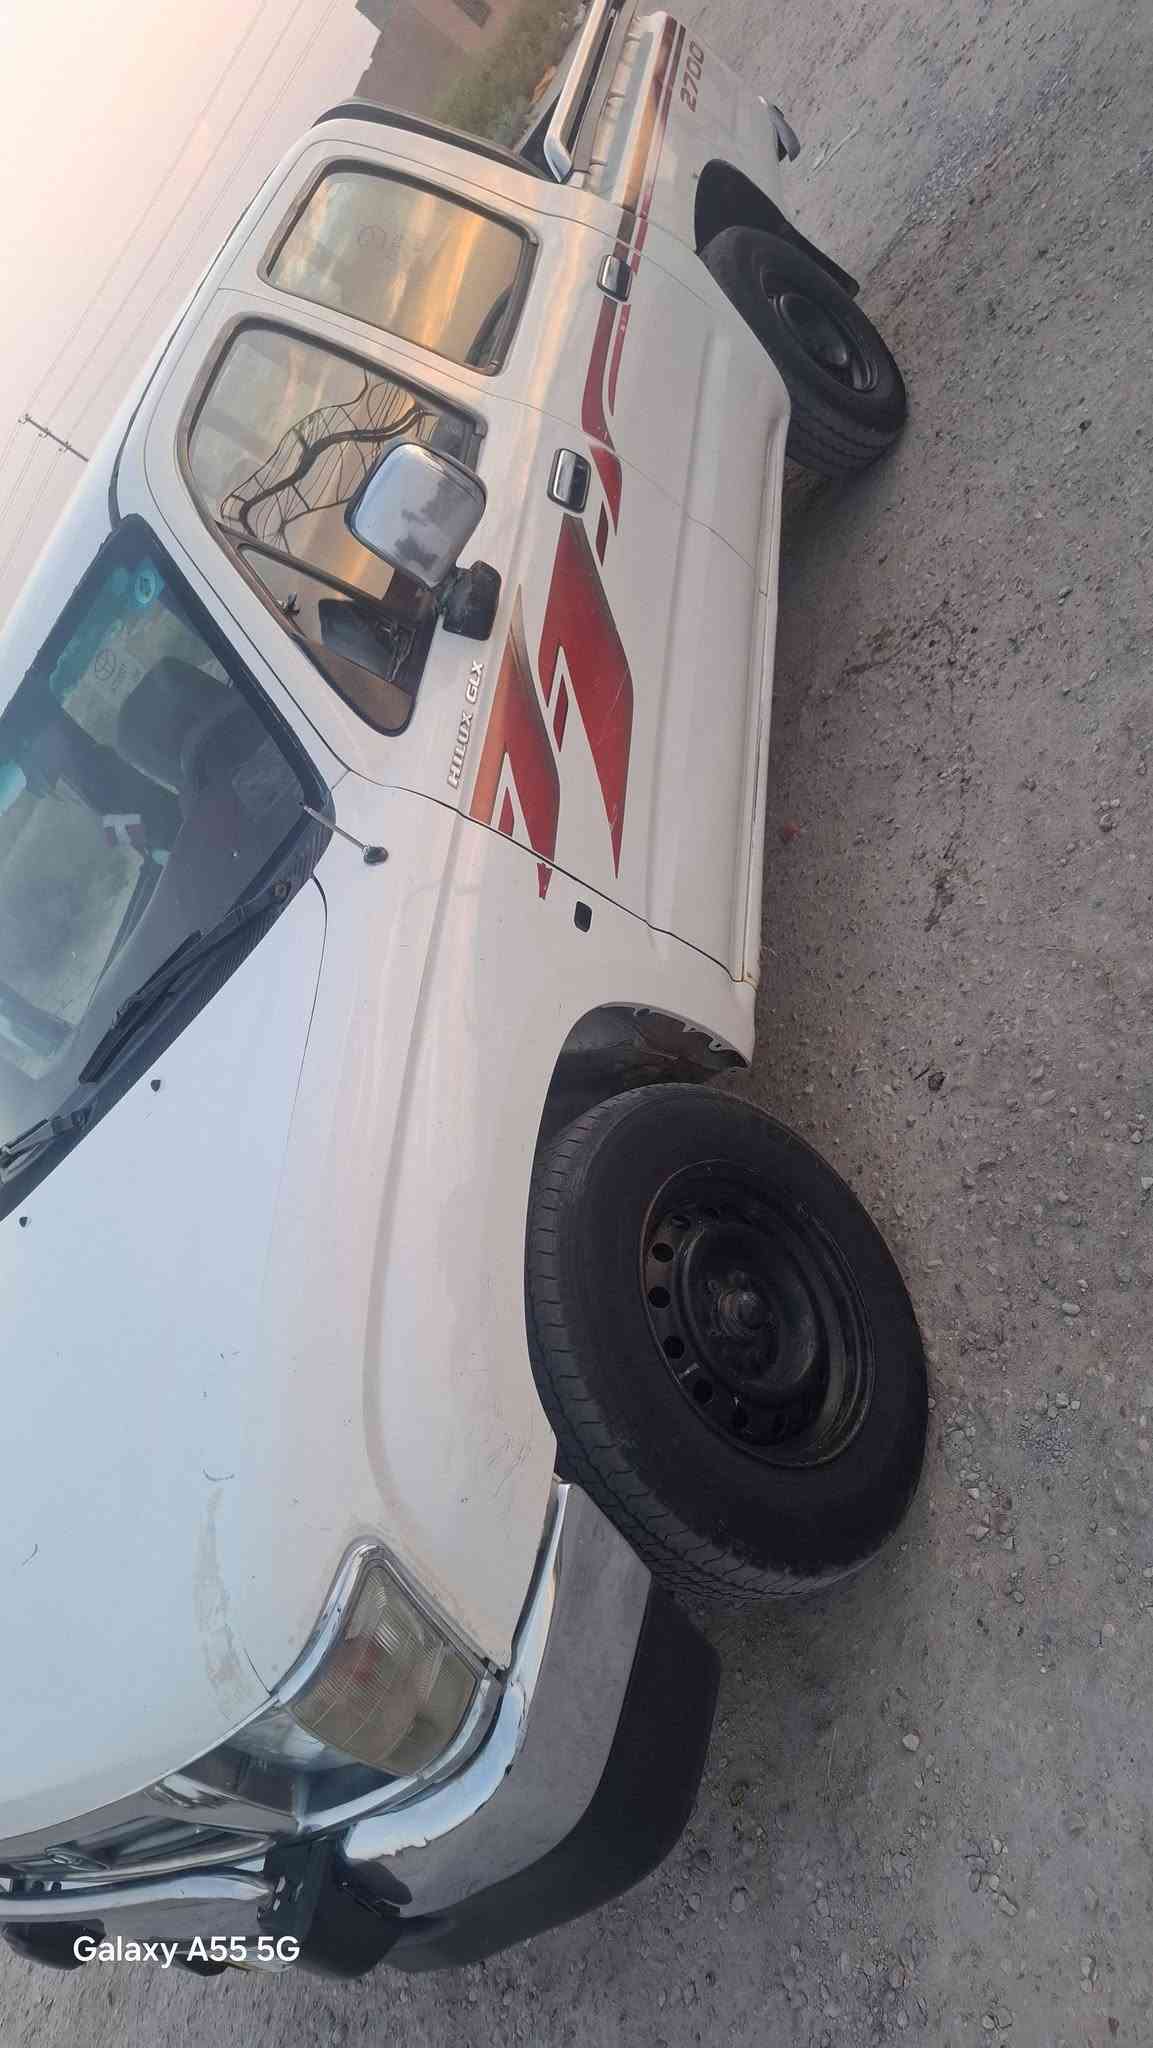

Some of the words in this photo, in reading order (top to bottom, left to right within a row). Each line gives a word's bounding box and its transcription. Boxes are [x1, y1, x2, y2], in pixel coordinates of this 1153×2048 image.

[680, 40, 704, 112] 2700
[447, 711, 473, 789] HILUX
[465, 660, 483, 704] GLX
